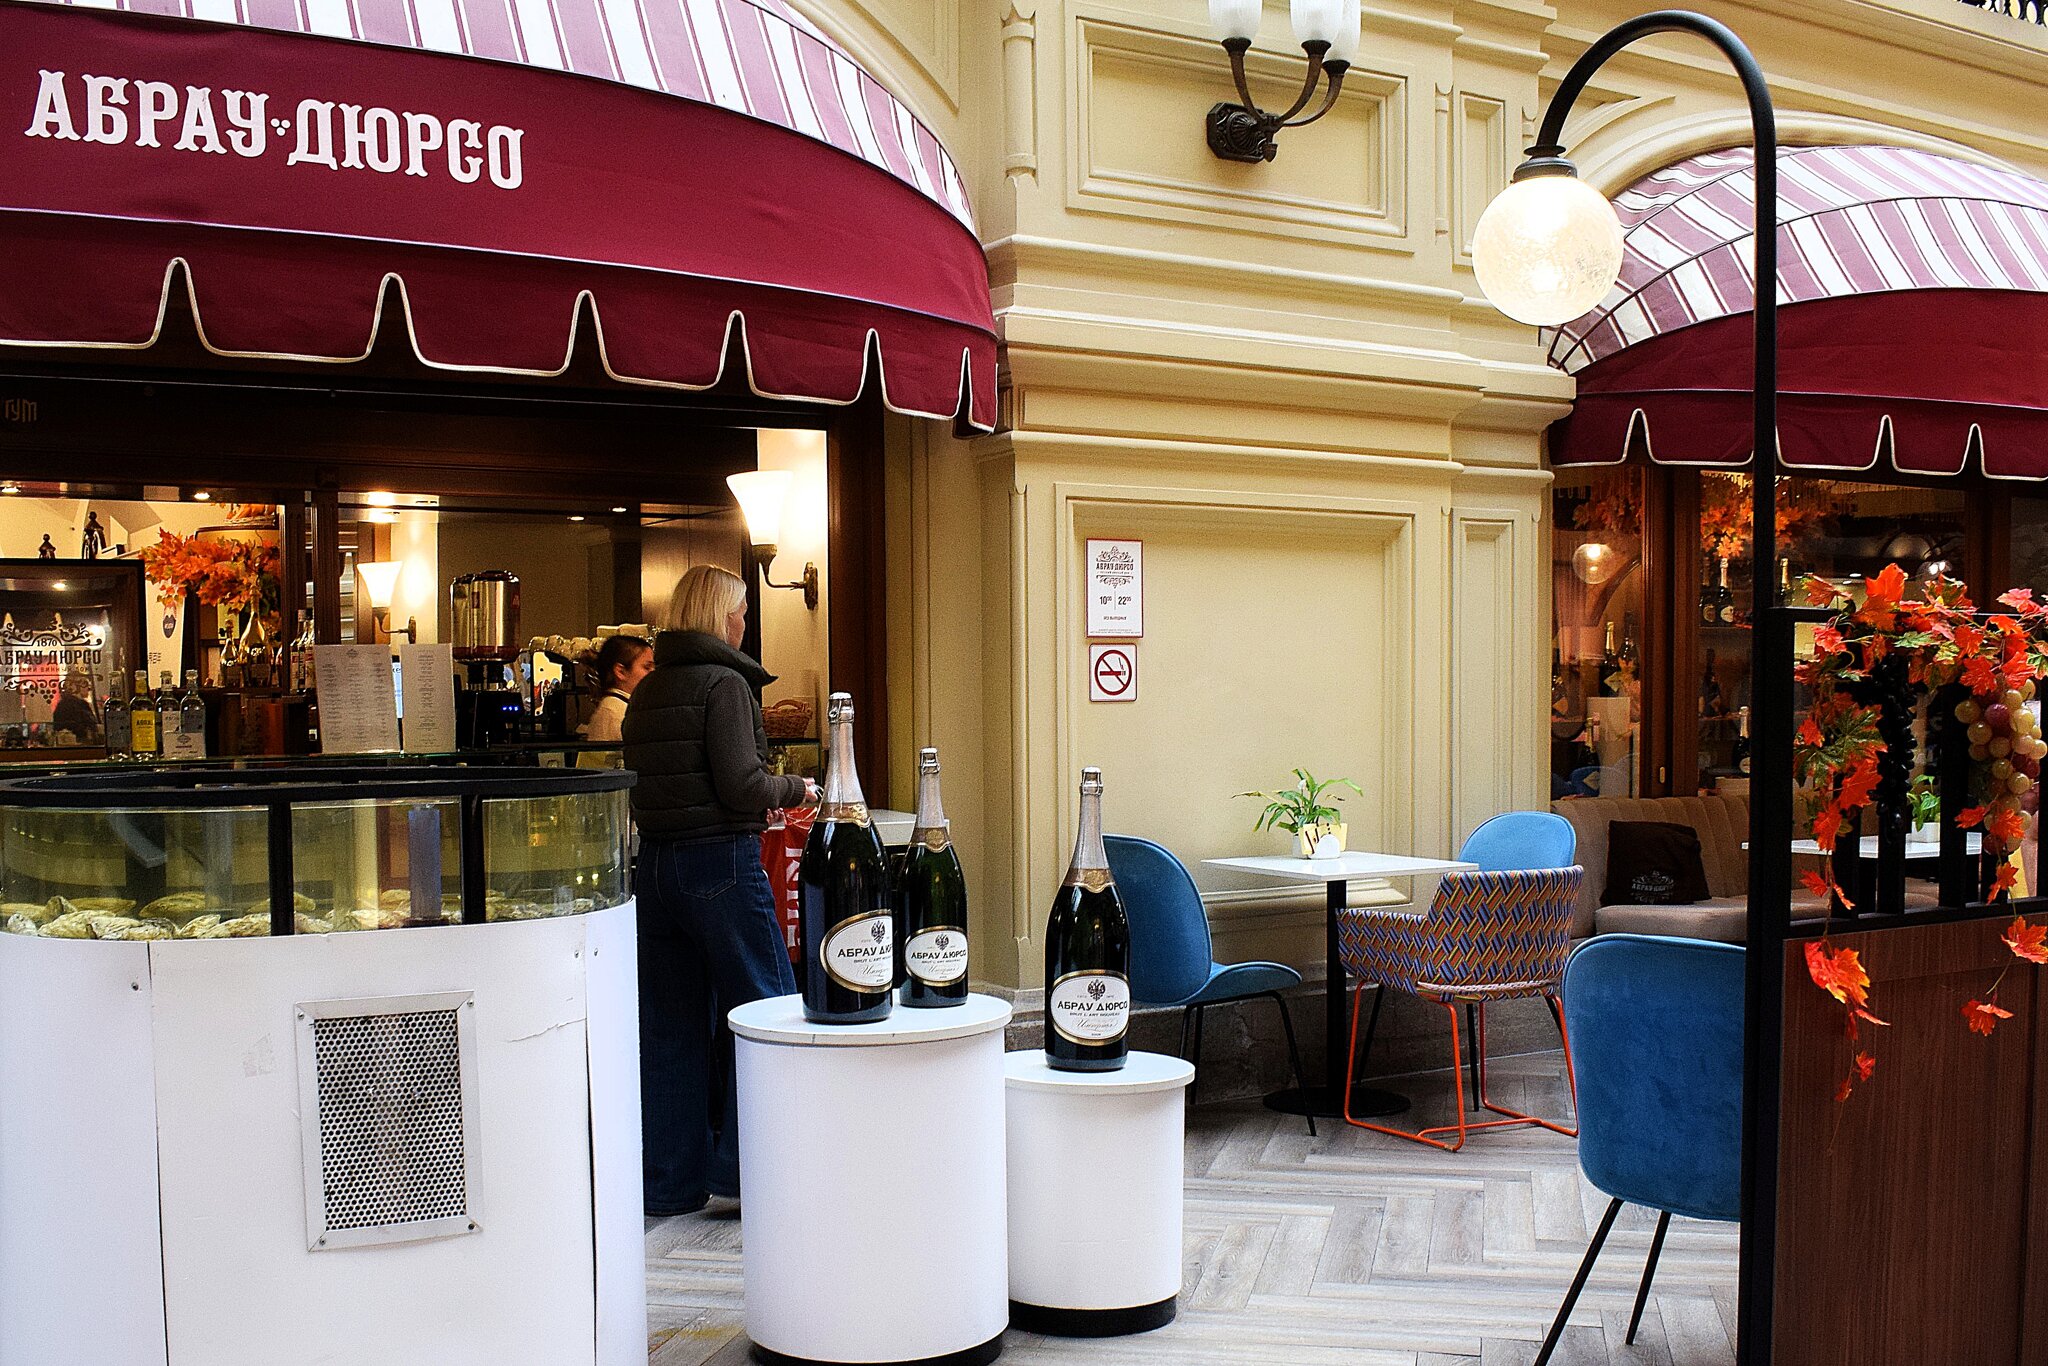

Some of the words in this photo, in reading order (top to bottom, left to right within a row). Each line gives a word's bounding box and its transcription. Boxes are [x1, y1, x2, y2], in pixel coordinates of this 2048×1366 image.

[24, 69, 270, 158] АБРАУ
[286, 98, 525, 190] ДЮРСО
[37, 637, 58, 647] 1870
[47, 650, 102, 665] ДЮРСО
[837, 946, 877, 958] АБРАУ
[911, 951, 941, 960] АБРАУ
[942, 949, 967, 959] ДЮРСО
[1057, 1001, 1094, 1011] АБРАУ
[1096, 1000, 1128, 1011] ДЮРСО
